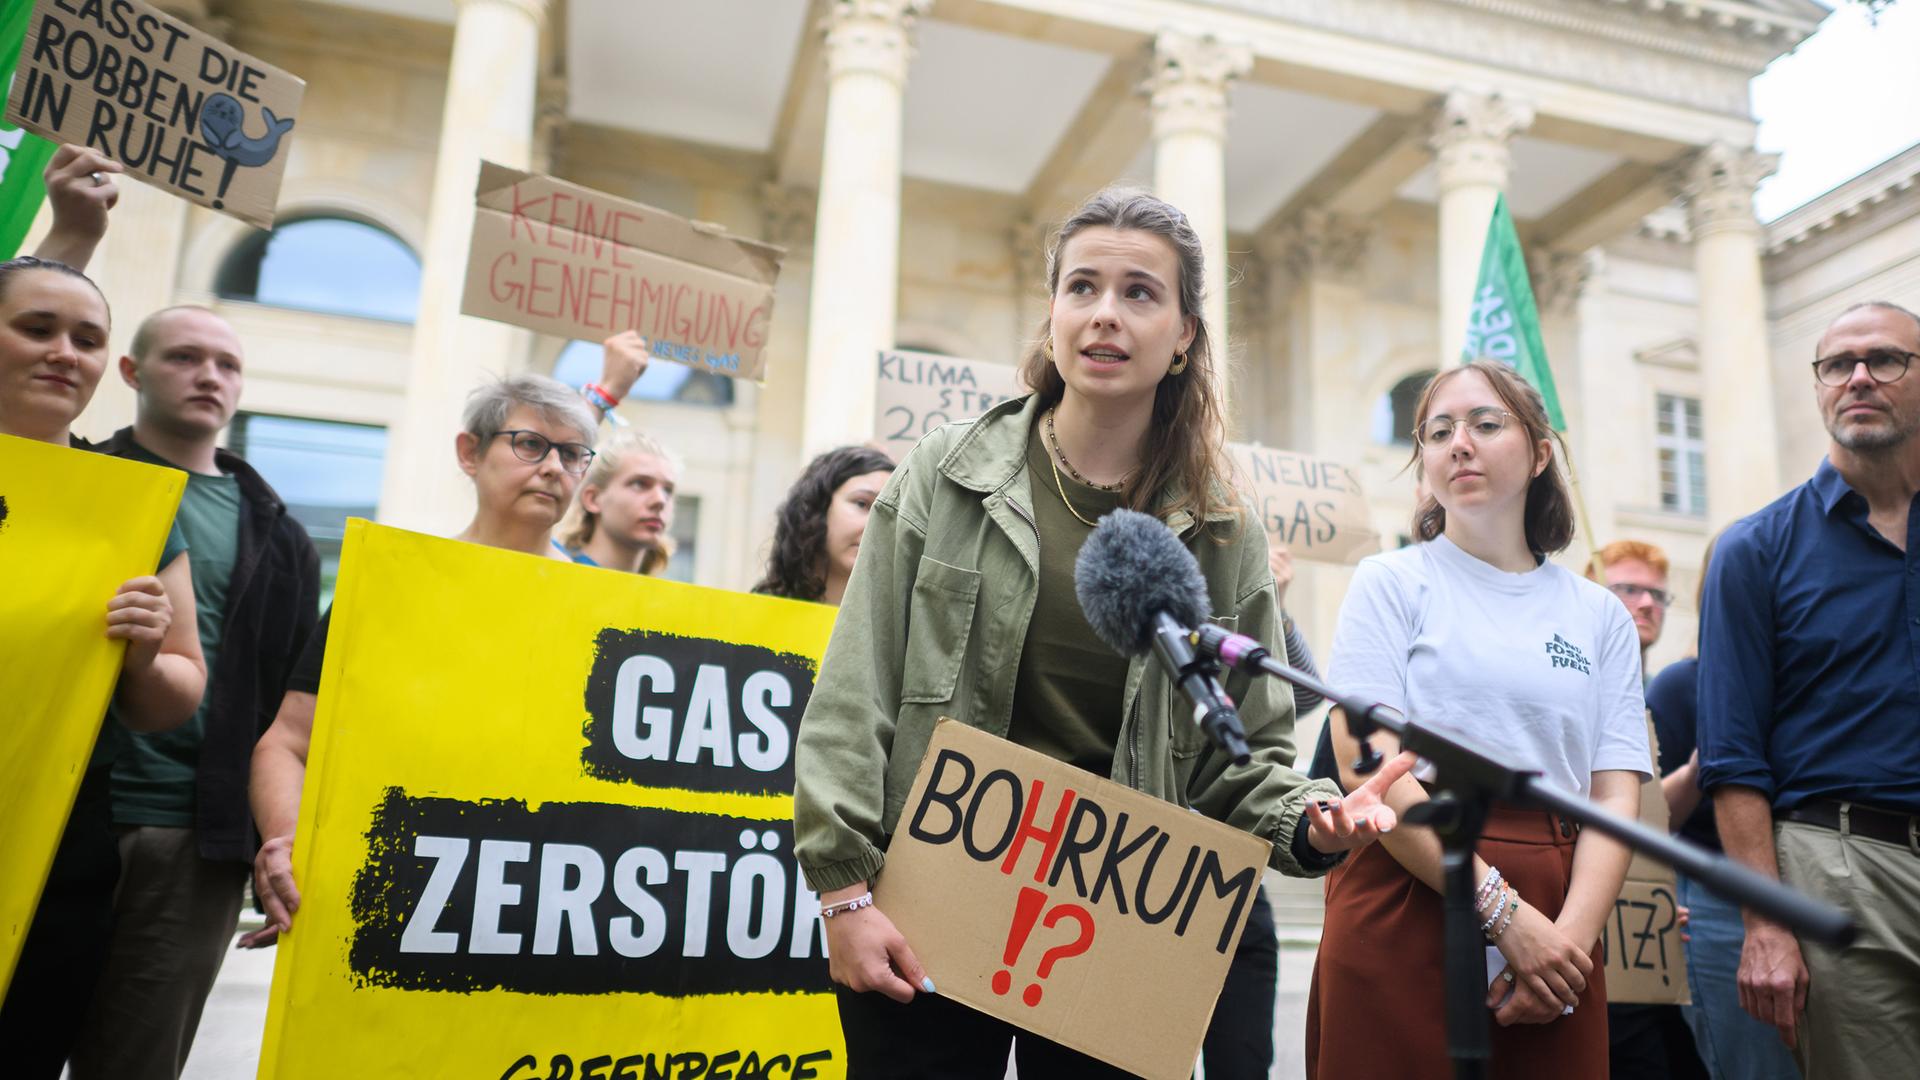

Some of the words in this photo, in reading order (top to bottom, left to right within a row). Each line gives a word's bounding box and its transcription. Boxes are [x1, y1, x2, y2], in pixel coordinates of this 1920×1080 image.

[19, 67, 71, 131] IN
[33, 14, 205, 135] ROBBEN
[198, 46, 266, 103] DIE
[509, 181, 643, 269] KEINE
[488, 251, 765, 349] GENEHMIGUNG
[877, 352, 978, 387] KLIMA
[1250, 450, 1363, 497] NEUES
[1545, 642, 1591, 665] FOSSIL
[1551, 655, 1590, 676] FUELS
[611, 654, 793, 773] GAS
[908, 748, 1257, 955] BOHRKUM
[991, 886, 1096, 1007] !?
